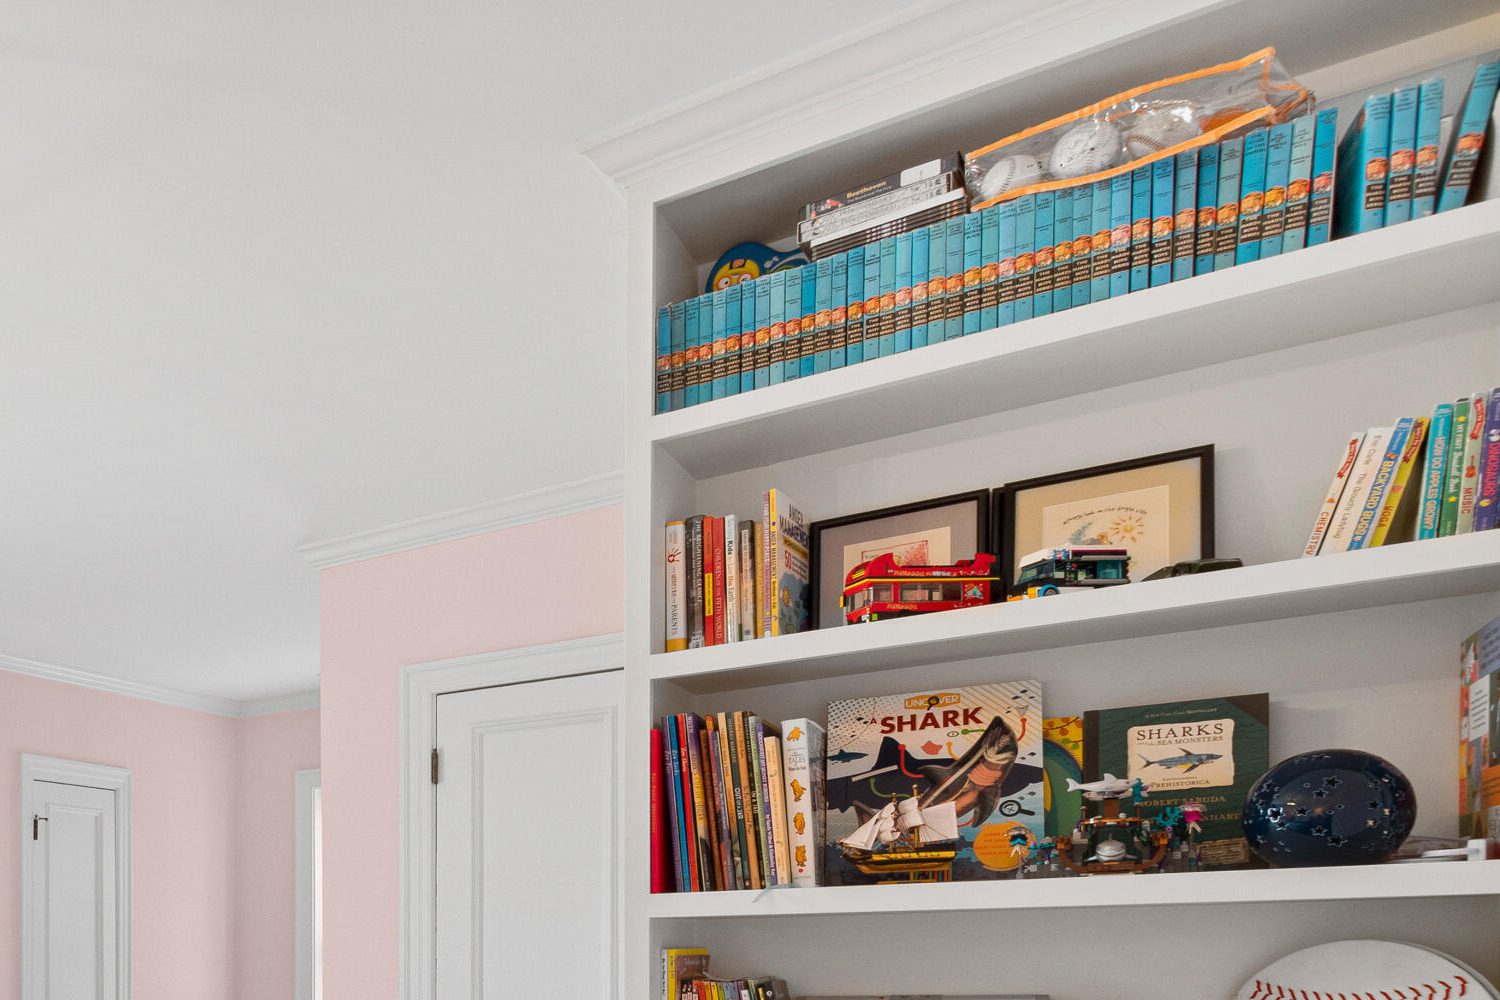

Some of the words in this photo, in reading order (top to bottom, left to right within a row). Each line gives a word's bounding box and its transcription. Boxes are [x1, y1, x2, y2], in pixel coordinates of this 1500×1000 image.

[1363, 447, 1376, 466] Carle
[1430, 435, 1445, 457] HOW
[1430, 456, 1442, 470] DO
[1482, 441, 1500, 496] DINOSAURS
[1355, 471, 1367, 485] The
[1364, 458, 1394, 510] BACKYARD
[1425, 469, 1441, 499] APPLES
[1461, 487, 1472, 514] MUSIC
[1332, 511, 1350, 540] Ladybug
[1353, 509, 1373, 536] BUGS
[1376, 503, 1393, 530] YOGA
[1421, 500, 1436, 530] GROW?
[1304, 510, 1330, 556] CHEMISTRY
[784, 550, 792, 569] 50
[880, 706, 984, 734] SHARK
[1136, 723, 1223, 741] SHARKS
[1174, 735, 1222, 744] MONSTERS
